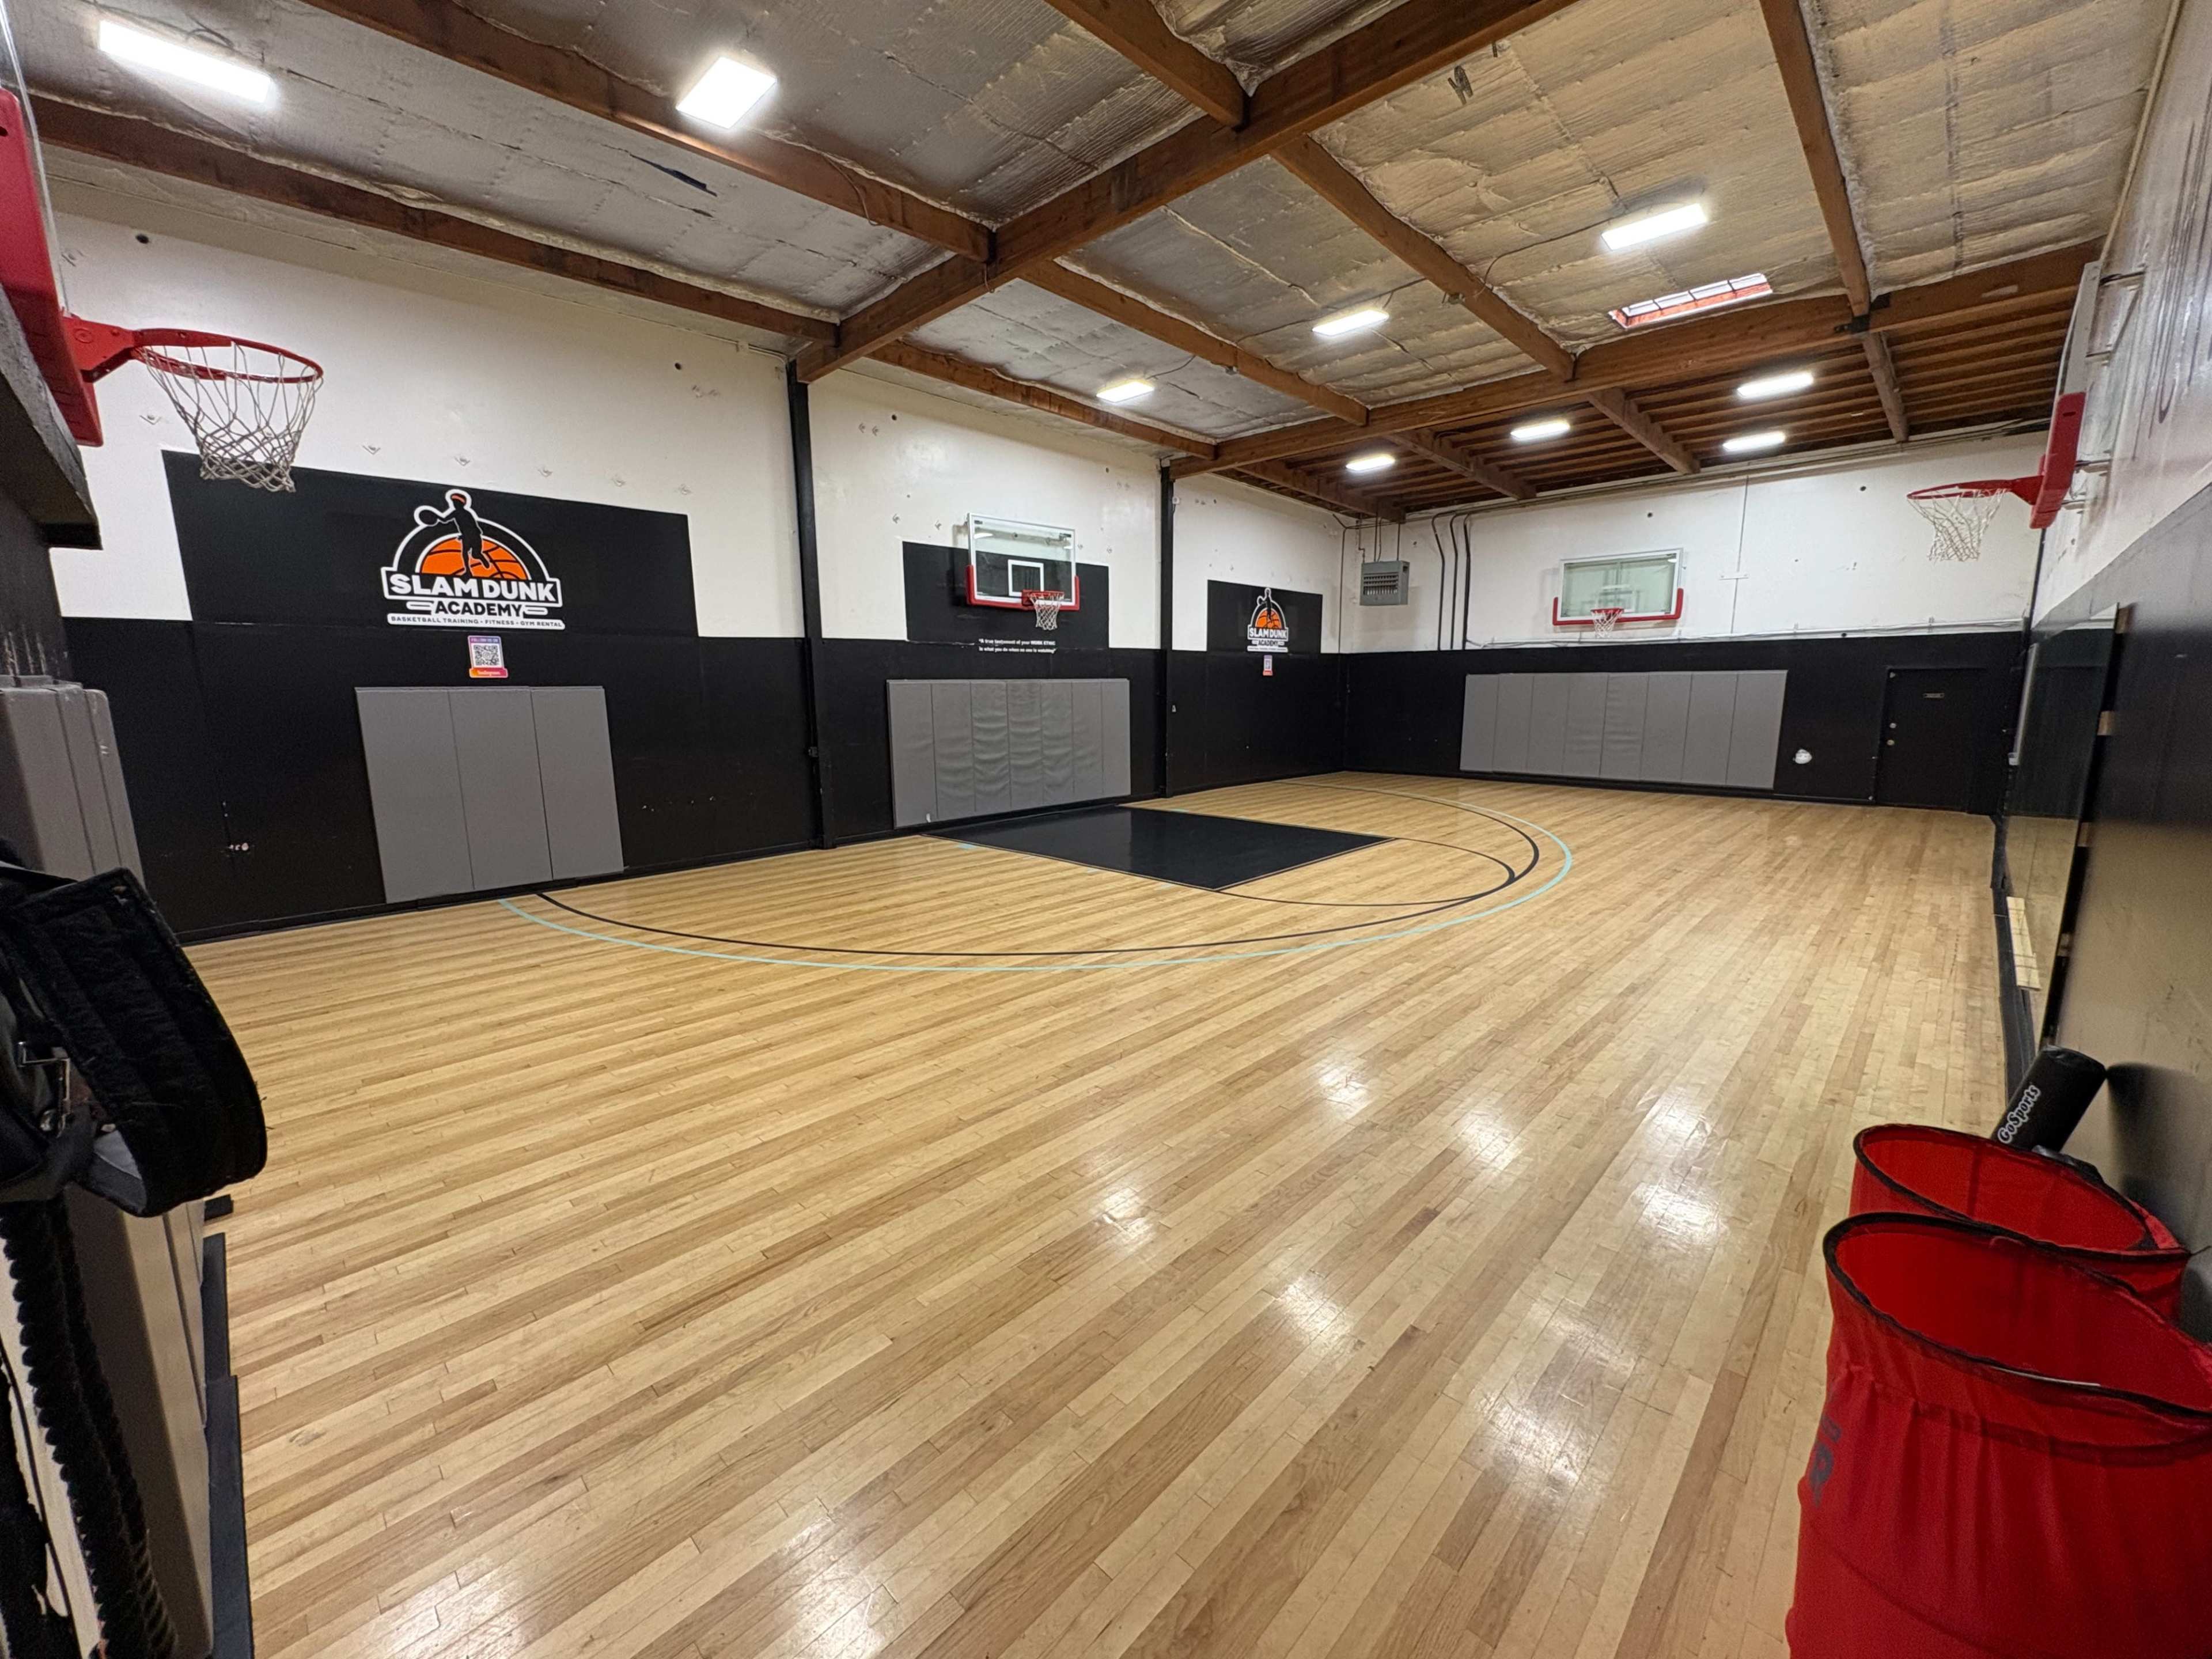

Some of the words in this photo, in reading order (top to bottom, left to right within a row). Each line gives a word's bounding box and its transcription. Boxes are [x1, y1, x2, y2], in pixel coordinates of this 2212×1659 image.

[390, 574, 479, 597] SLAM
[482, 579, 556, 601] DUNK
[435, 601, 522, 617] ACADEMY
[1250, 628, 1268, 637] SLAM
[1270, 629, 1286, 638] DUNK
[1997, 1084, 2041, 1143] GoSports
